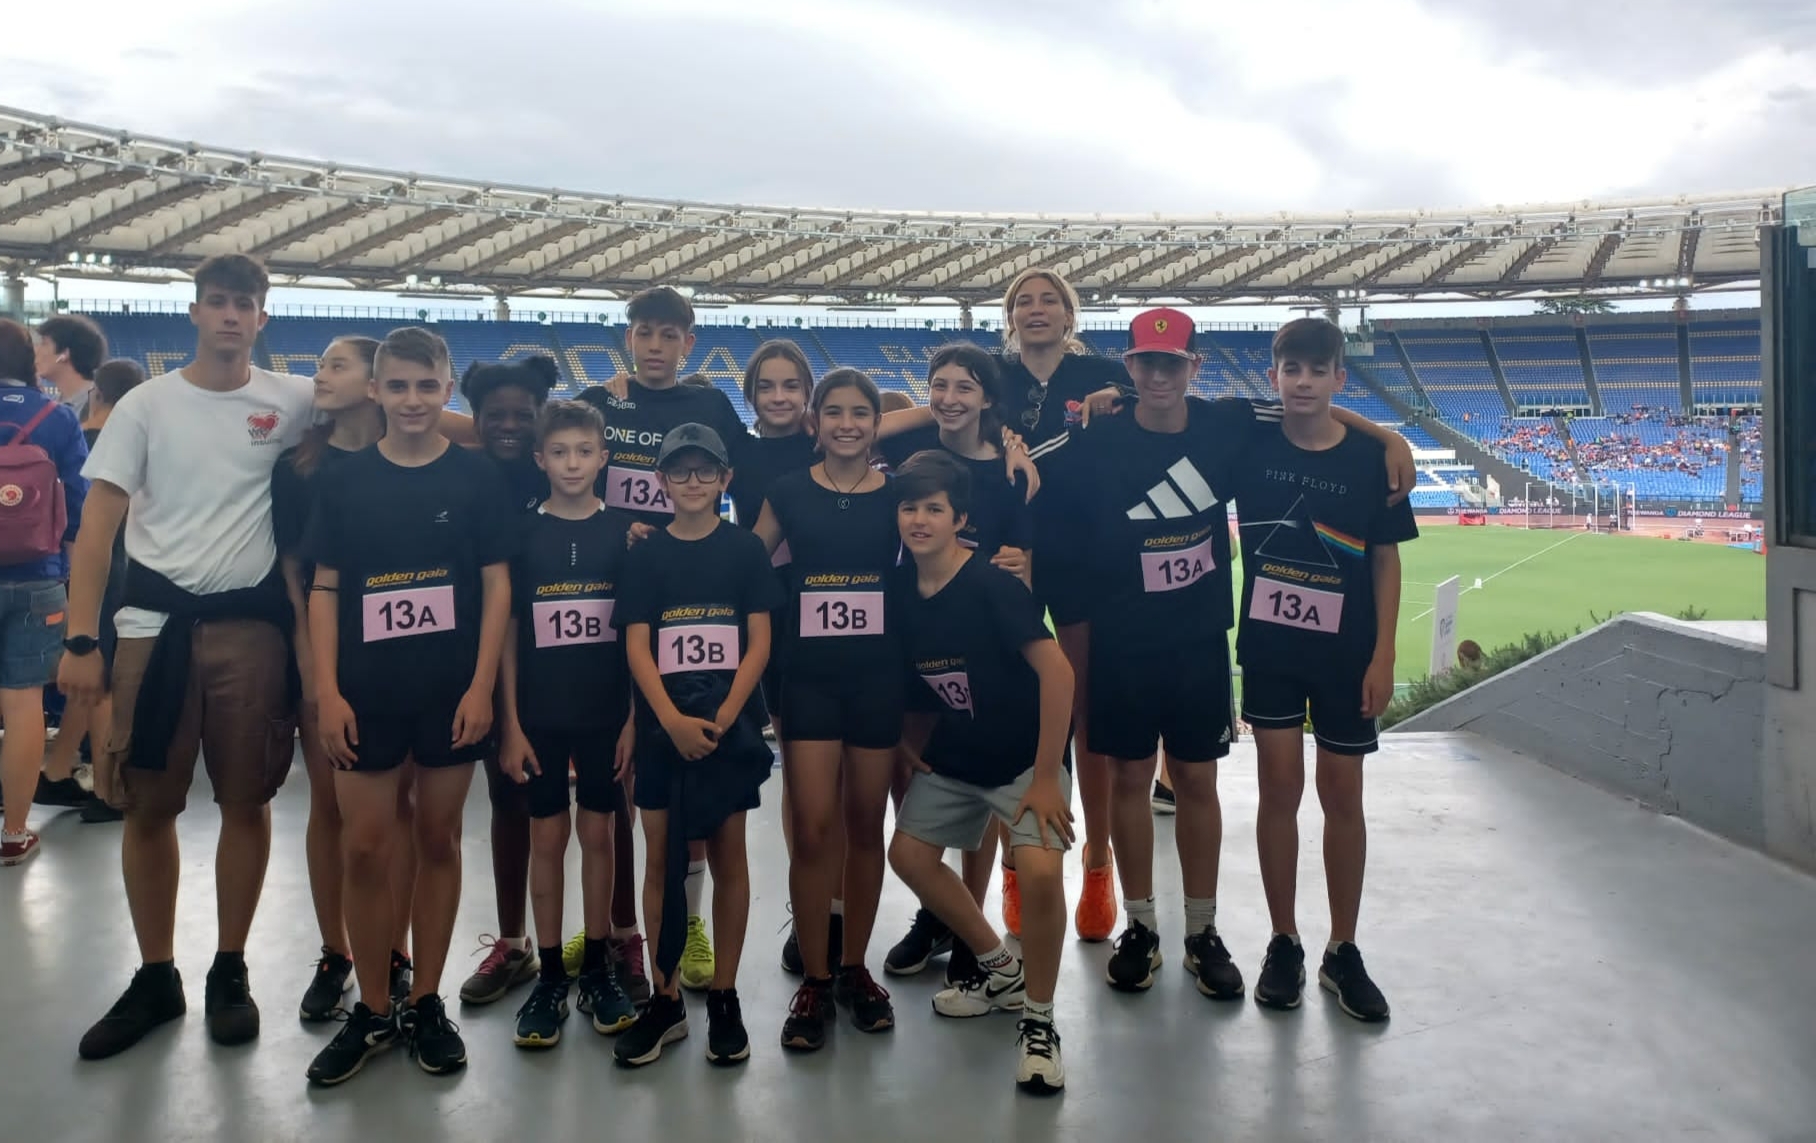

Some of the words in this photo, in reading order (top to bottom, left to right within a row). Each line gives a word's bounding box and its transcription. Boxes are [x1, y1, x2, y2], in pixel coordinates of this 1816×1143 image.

[604, 426, 636, 444] ONE
[639, 432, 662, 446] OF
[613, 453, 656, 464] golden
[620, 477, 667, 508] 13A
[1266, 469, 1295, 482] PINK
[1302, 476, 1347, 494] FLOYD
[1678, 510, 1716, 518] DIAMOND
[1718, 511, 1751, 519] LEAGUE
[1144, 534, 1189, 547] golden
[366, 571, 415, 588] golden
[416, 568, 449, 581] gala
[805, 574, 849, 585] golden
[851, 574, 880, 584] gala
[1158, 558, 1203, 584] 13A
[1262, 563, 1309, 579] golden
[1310, 573, 1341, 585] gala
[536, 583, 583, 595] golden
[379, 600, 437, 631] 13A
[662, 607, 705, 620] golden
[707, 607, 734, 617] gala
[816, 601, 868, 630] 13B
[1269, 590, 1321, 626] 13A
[549, 610, 601, 639] 13B
[671, 635, 725, 665] 13B
[938, 681, 968, 705] 13
